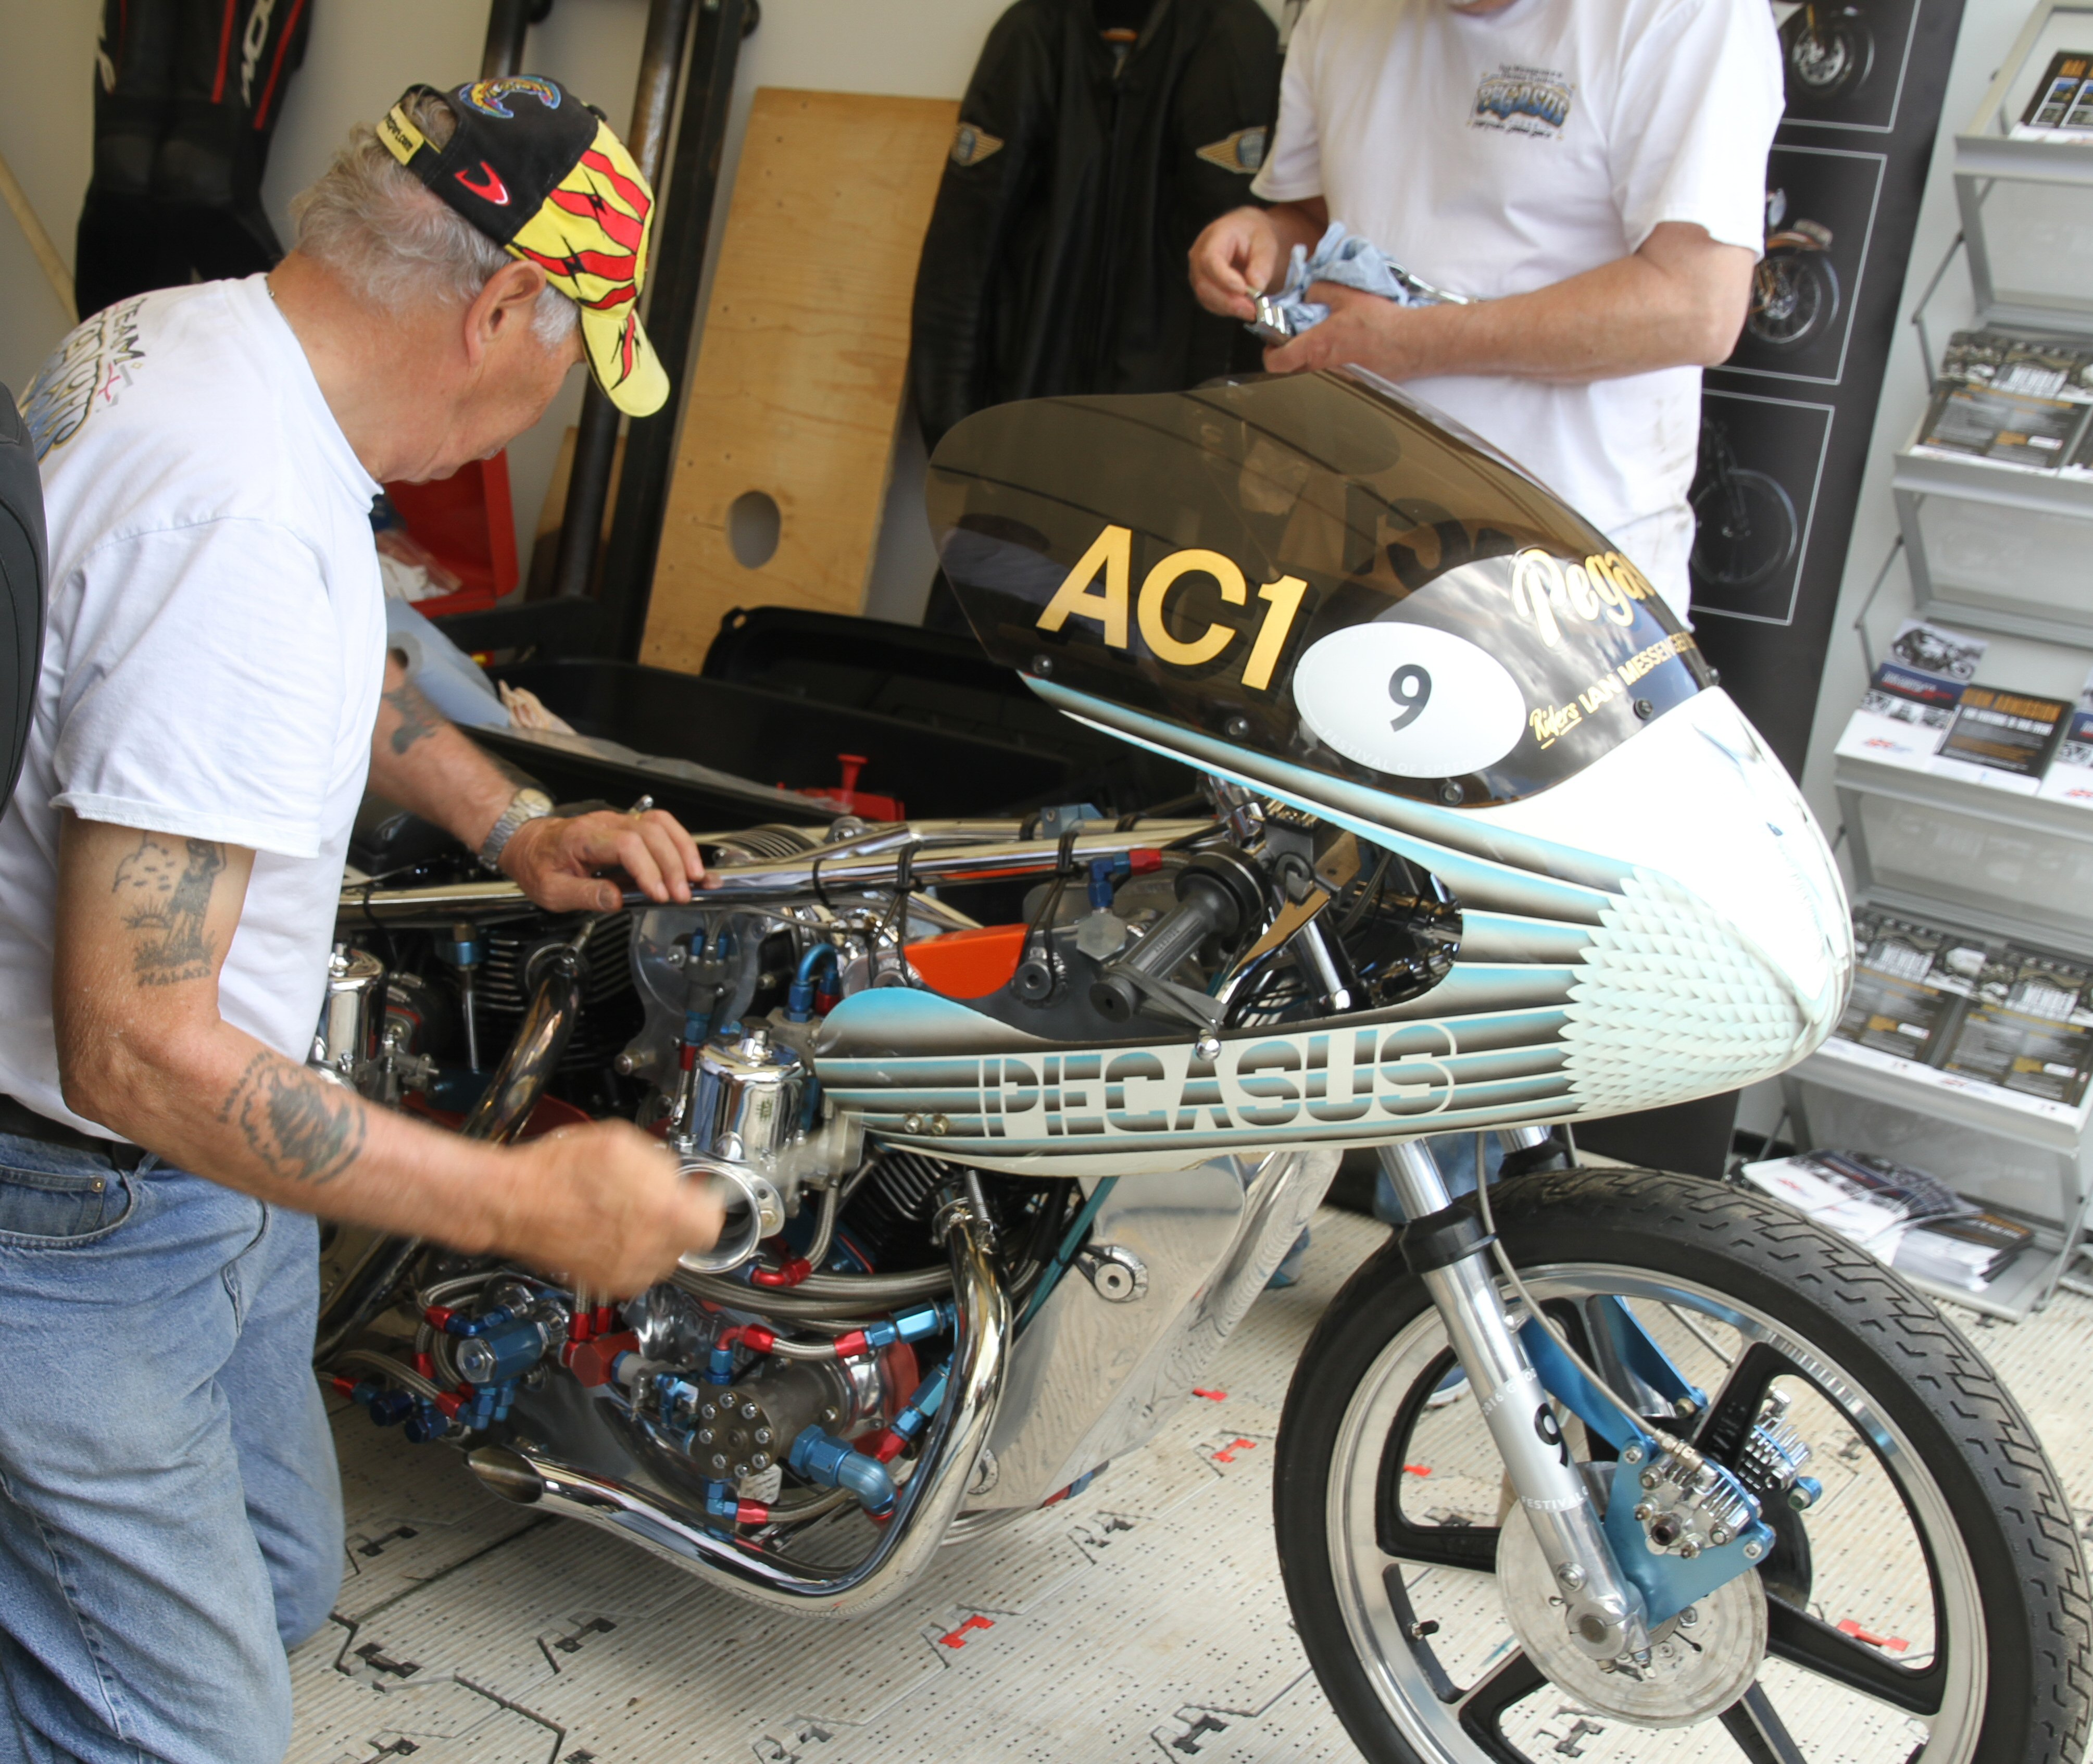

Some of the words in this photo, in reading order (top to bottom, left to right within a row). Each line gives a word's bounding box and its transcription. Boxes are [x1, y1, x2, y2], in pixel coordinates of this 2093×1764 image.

[1036, 524, 1308, 691] AC1
[1388, 664, 1432, 732] 9
[1530, 703, 1581, 742] Riders
[1578, 673, 1623, 714] IAN
[1323, 729, 1390, 771] FESTIVAL
[1396, 764, 1418, 774] OF
[1424, 759, 1473, 775] SPEED
[979, 1023, 1455, 1137] PEGASUS
[1534, 1402, 1569, 1468] 9
